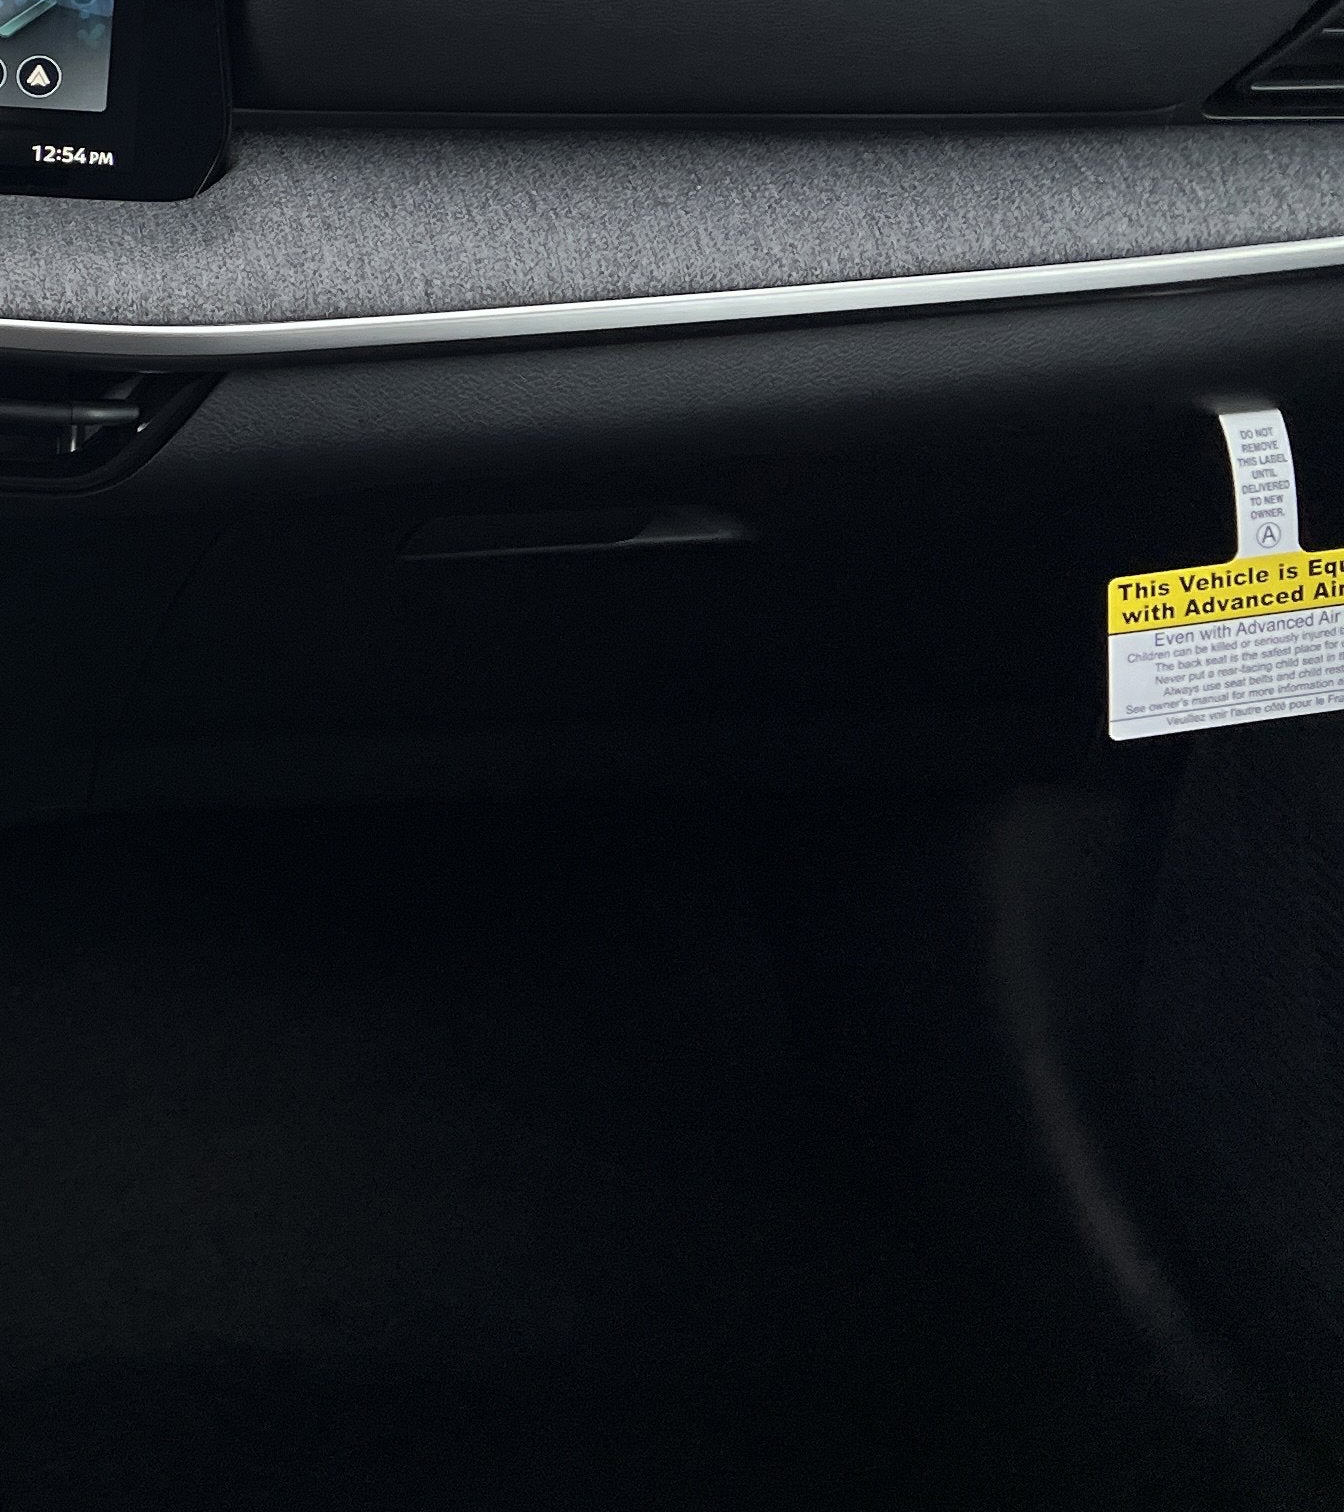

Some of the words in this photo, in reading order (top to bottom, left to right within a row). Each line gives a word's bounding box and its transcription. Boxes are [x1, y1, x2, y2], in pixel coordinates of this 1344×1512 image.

[31, 144, 87, 165] 12:54
[89, 150, 114, 166] PM
[1239, 430, 1253, 440] DO
[1255, 427, 1273, 437] NOT
[1242, 440, 1279, 453] REMOVE
[1237, 456, 1257, 467] THIS
[1259, 453, 1288, 465] LABEL
[1252, 468, 1278, 480] UNTIL
[1241, 479, 1291, 495] DELIVERED
[1250, 496, 1262, 506] TO
[1264, 494, 1284, 504] NEW
[1261, 525, 1277, 544] A
[1117, 580, 1170, 601] This
[1179, 567, 1269, 593] Vehicle
[1278, 563, 1298, 580] is
[1122, 602, 1176, 624] with
[1184, 584, 1304, 617] Advanced
[1154, 631, 1195, 647] Even
[1199, 622, 1232, 641] with
[1236, 612, 1314, 637] Advanced
[1318, 610, 1342, 626] Air
[1127, 650, 1171, 664] Children
[1173, 647, 1192, 657] can
[1195, 644, 1209, 654] be
[1211, 640, 1237, 652] killed
[1241, 640, 1250, 648] or
[1254, 632, 1299, 647] seriously
[1302, 626, 1337, 640] injured
[1155, 662, 1175, 673] The
[1178, 658, 1202, 669] back
[1205, 654, 1227, 666] seat
[1242, 651, 1258, 661] the
[1261, 646, 1292, 659] safest
[1294, 642, 1321, 656] place
[1155, 673, 1186, 685] Never
[1188, 670, 1205, 683] put
[1275, 657, 1299, 669] child
[1302, 654, 1324, 666] seat
[1163, 684, 1200, 696] Always
[1202, 682, 1221, 692] use
[1224, 677, 1246, 689] seat
[1248, 674, 1274, 686] belts
[1276, 669, 1296, 682] and
[1298, 666, 1322, 679] child
[1125, 704, 1146, 715] See
[1148, 698, 1189, 712] owner's
[1192, 692, 1229, 705] manual
[1232, 690, 1245, 700] for
[1248, 687, 1274, 698] more
[1278, 679, 1334, 694] information
[1288, 699, 1313, 711] pour
